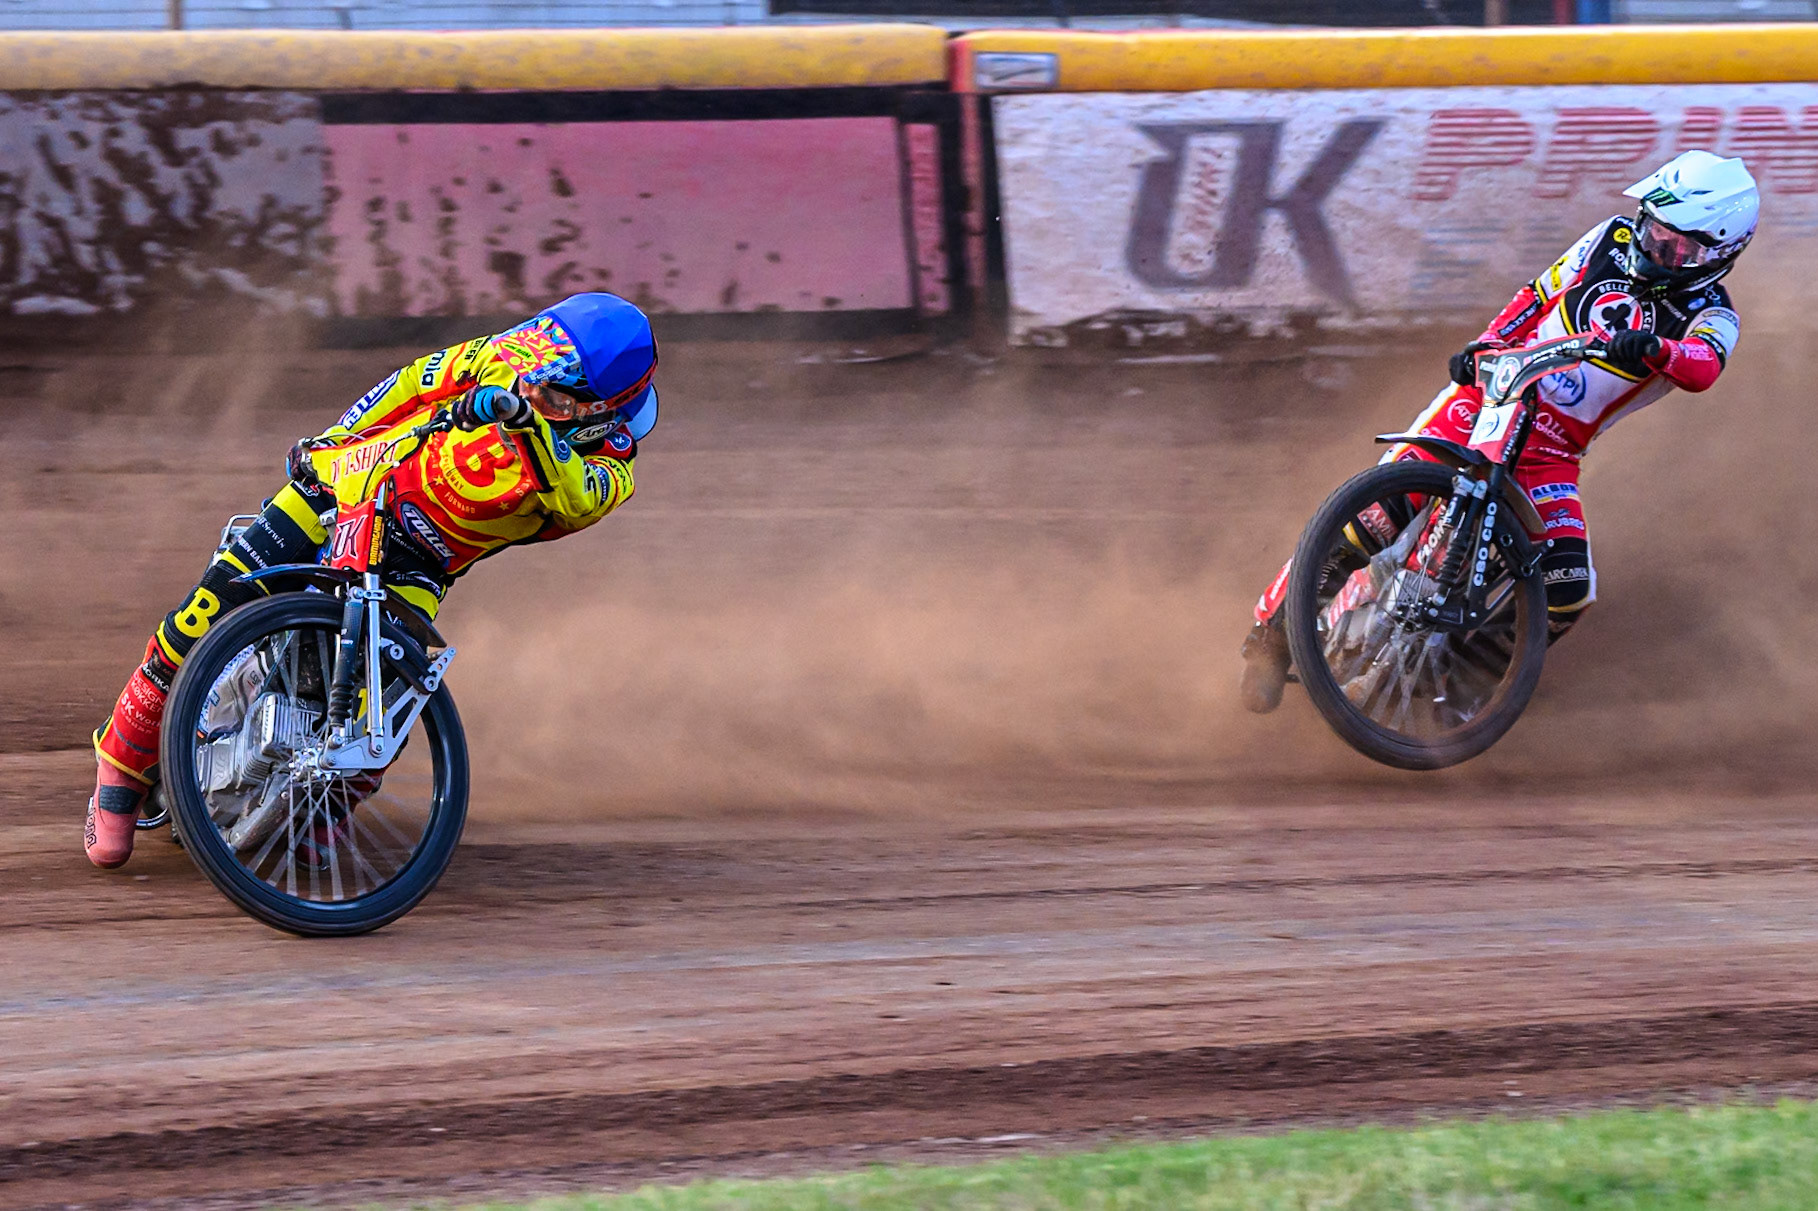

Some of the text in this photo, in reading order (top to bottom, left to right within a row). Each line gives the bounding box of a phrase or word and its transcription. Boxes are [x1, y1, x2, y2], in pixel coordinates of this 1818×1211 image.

[1127, 119, 1387, 306] UK
[1598, 283, 1630, 294] BELLE
[1643, 311, 1653, 330] ACE
[452, 423, 517, 488] B
[443, 491, 476, 514] FORWARD
[332, 514, 369, 561] UK
[368, 515, 383, 566] BIRMINGHAM
[404, 509, 456, 558] TOLLEY
[174, 586, 220, 638] B
[121, 693, 135, 716] SK
[132, 671, 167, 706] DESIGN
